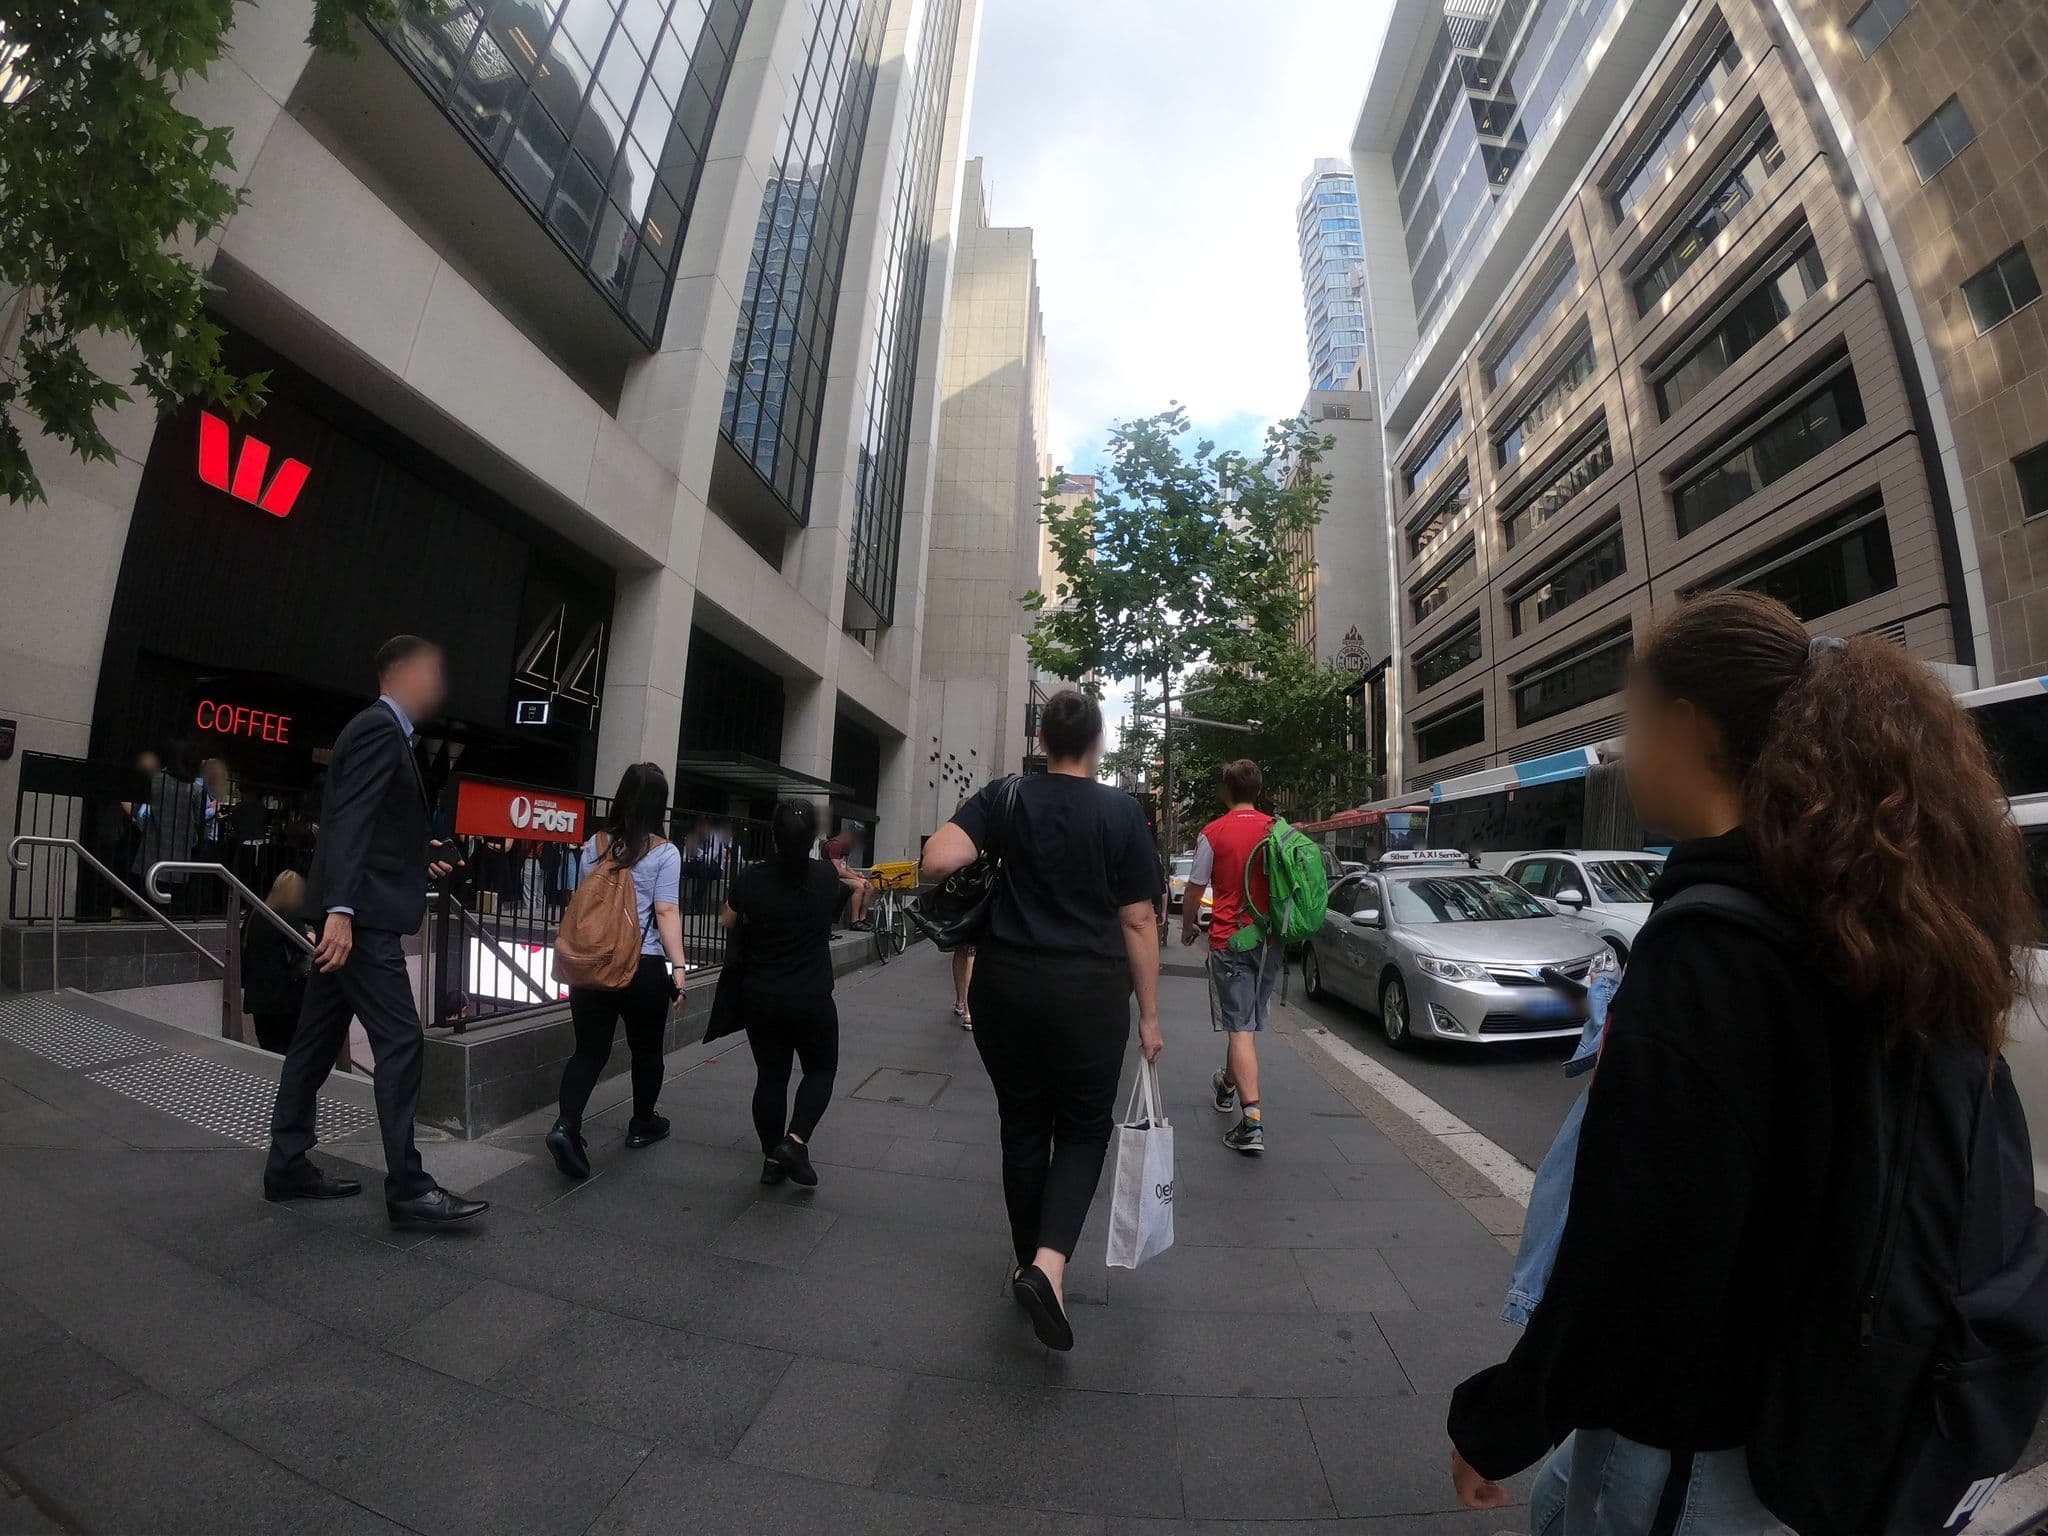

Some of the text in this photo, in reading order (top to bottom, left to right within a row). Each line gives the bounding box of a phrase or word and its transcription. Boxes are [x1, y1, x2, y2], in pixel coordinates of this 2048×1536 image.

[514, 600, 604, 730] 44
[197, 700, 291, 744] COFFEE
[532, 807, 578, 833] POST
[1412, 851, 1437, 859] TAXI
